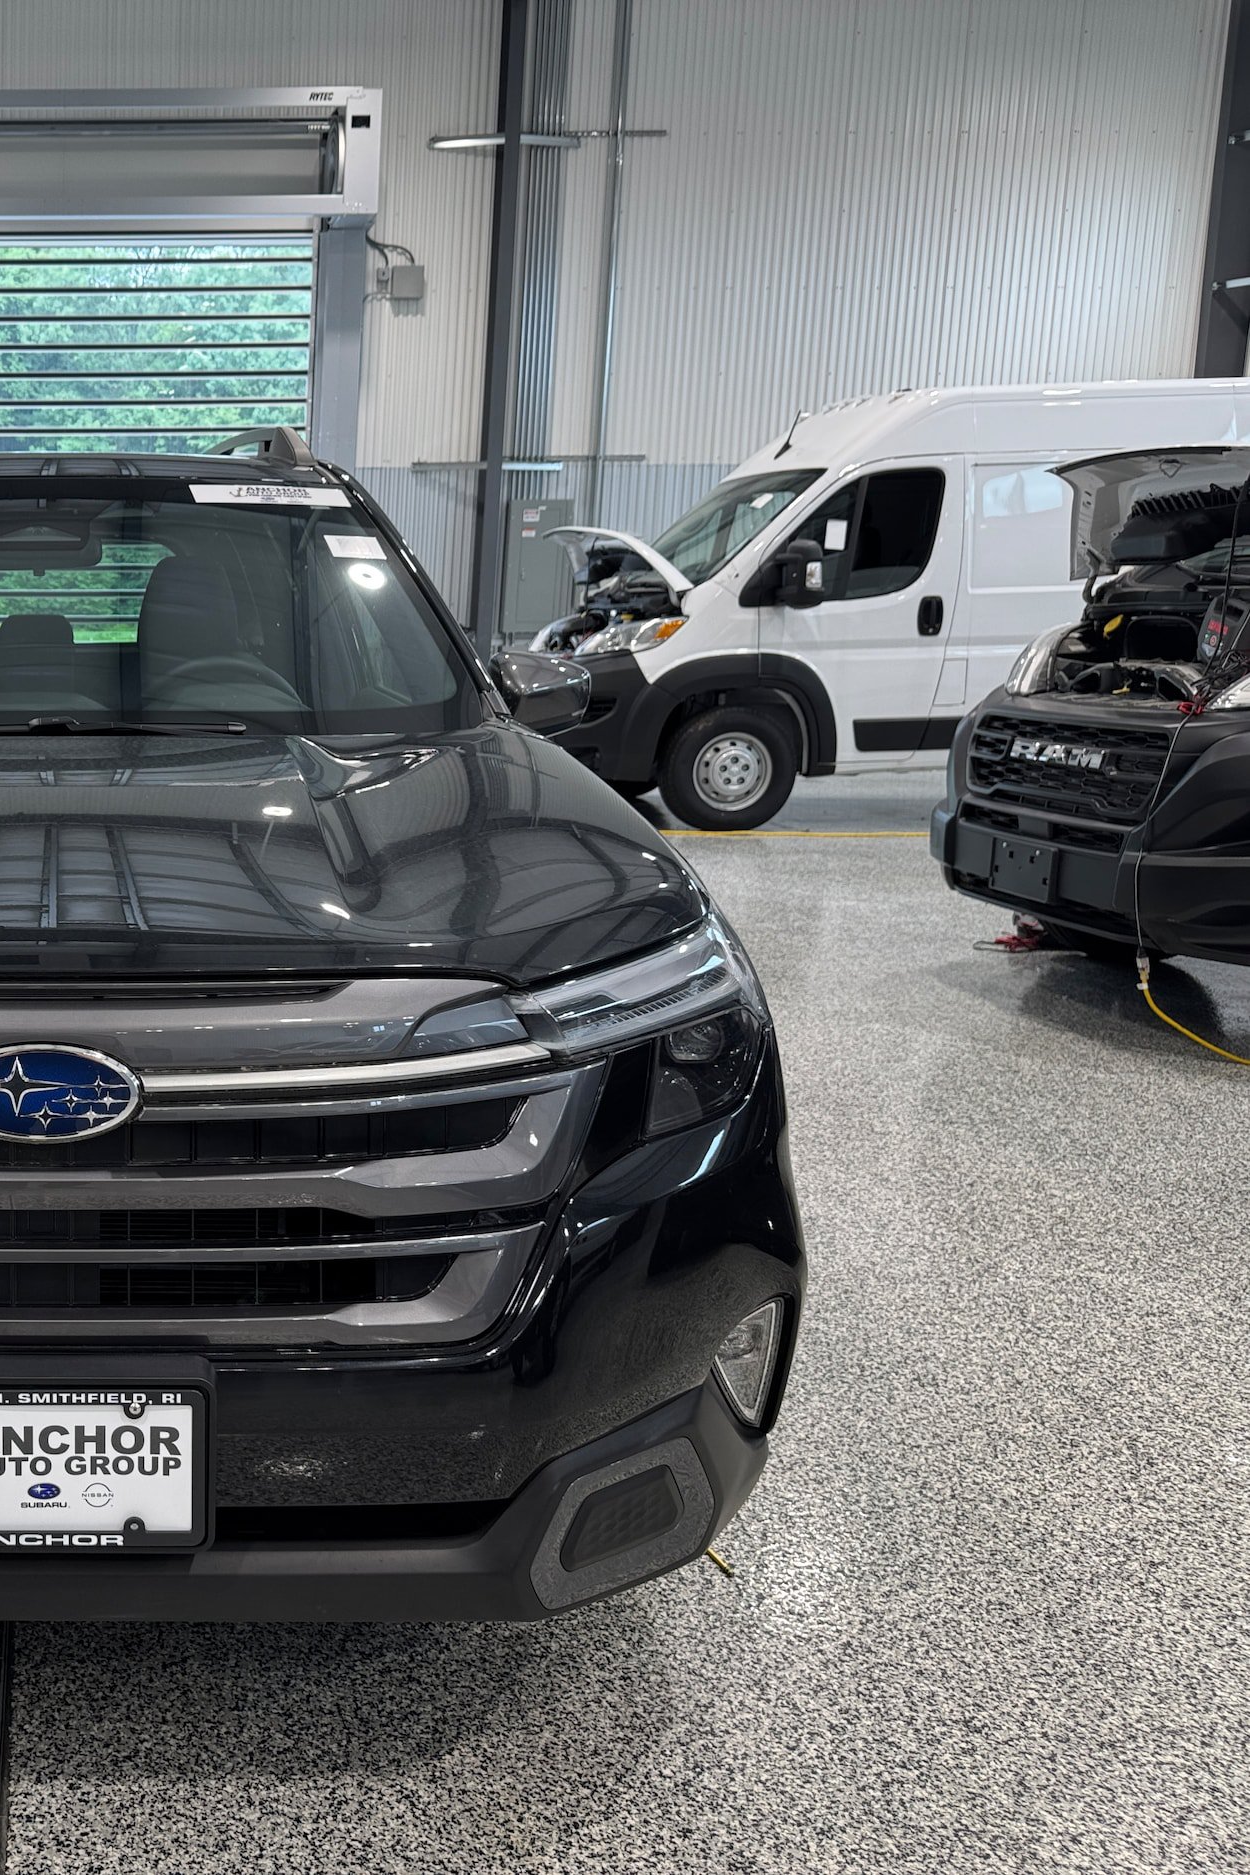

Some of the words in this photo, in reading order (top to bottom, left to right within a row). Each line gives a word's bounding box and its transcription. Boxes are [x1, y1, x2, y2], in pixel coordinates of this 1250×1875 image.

[309, 92, 334, 101] RYTEC
[1010, 737, 1105, 769] RAM
[161, 1393, 182, 1404] RI
[64, 1455, 182, 1477] GROUP
